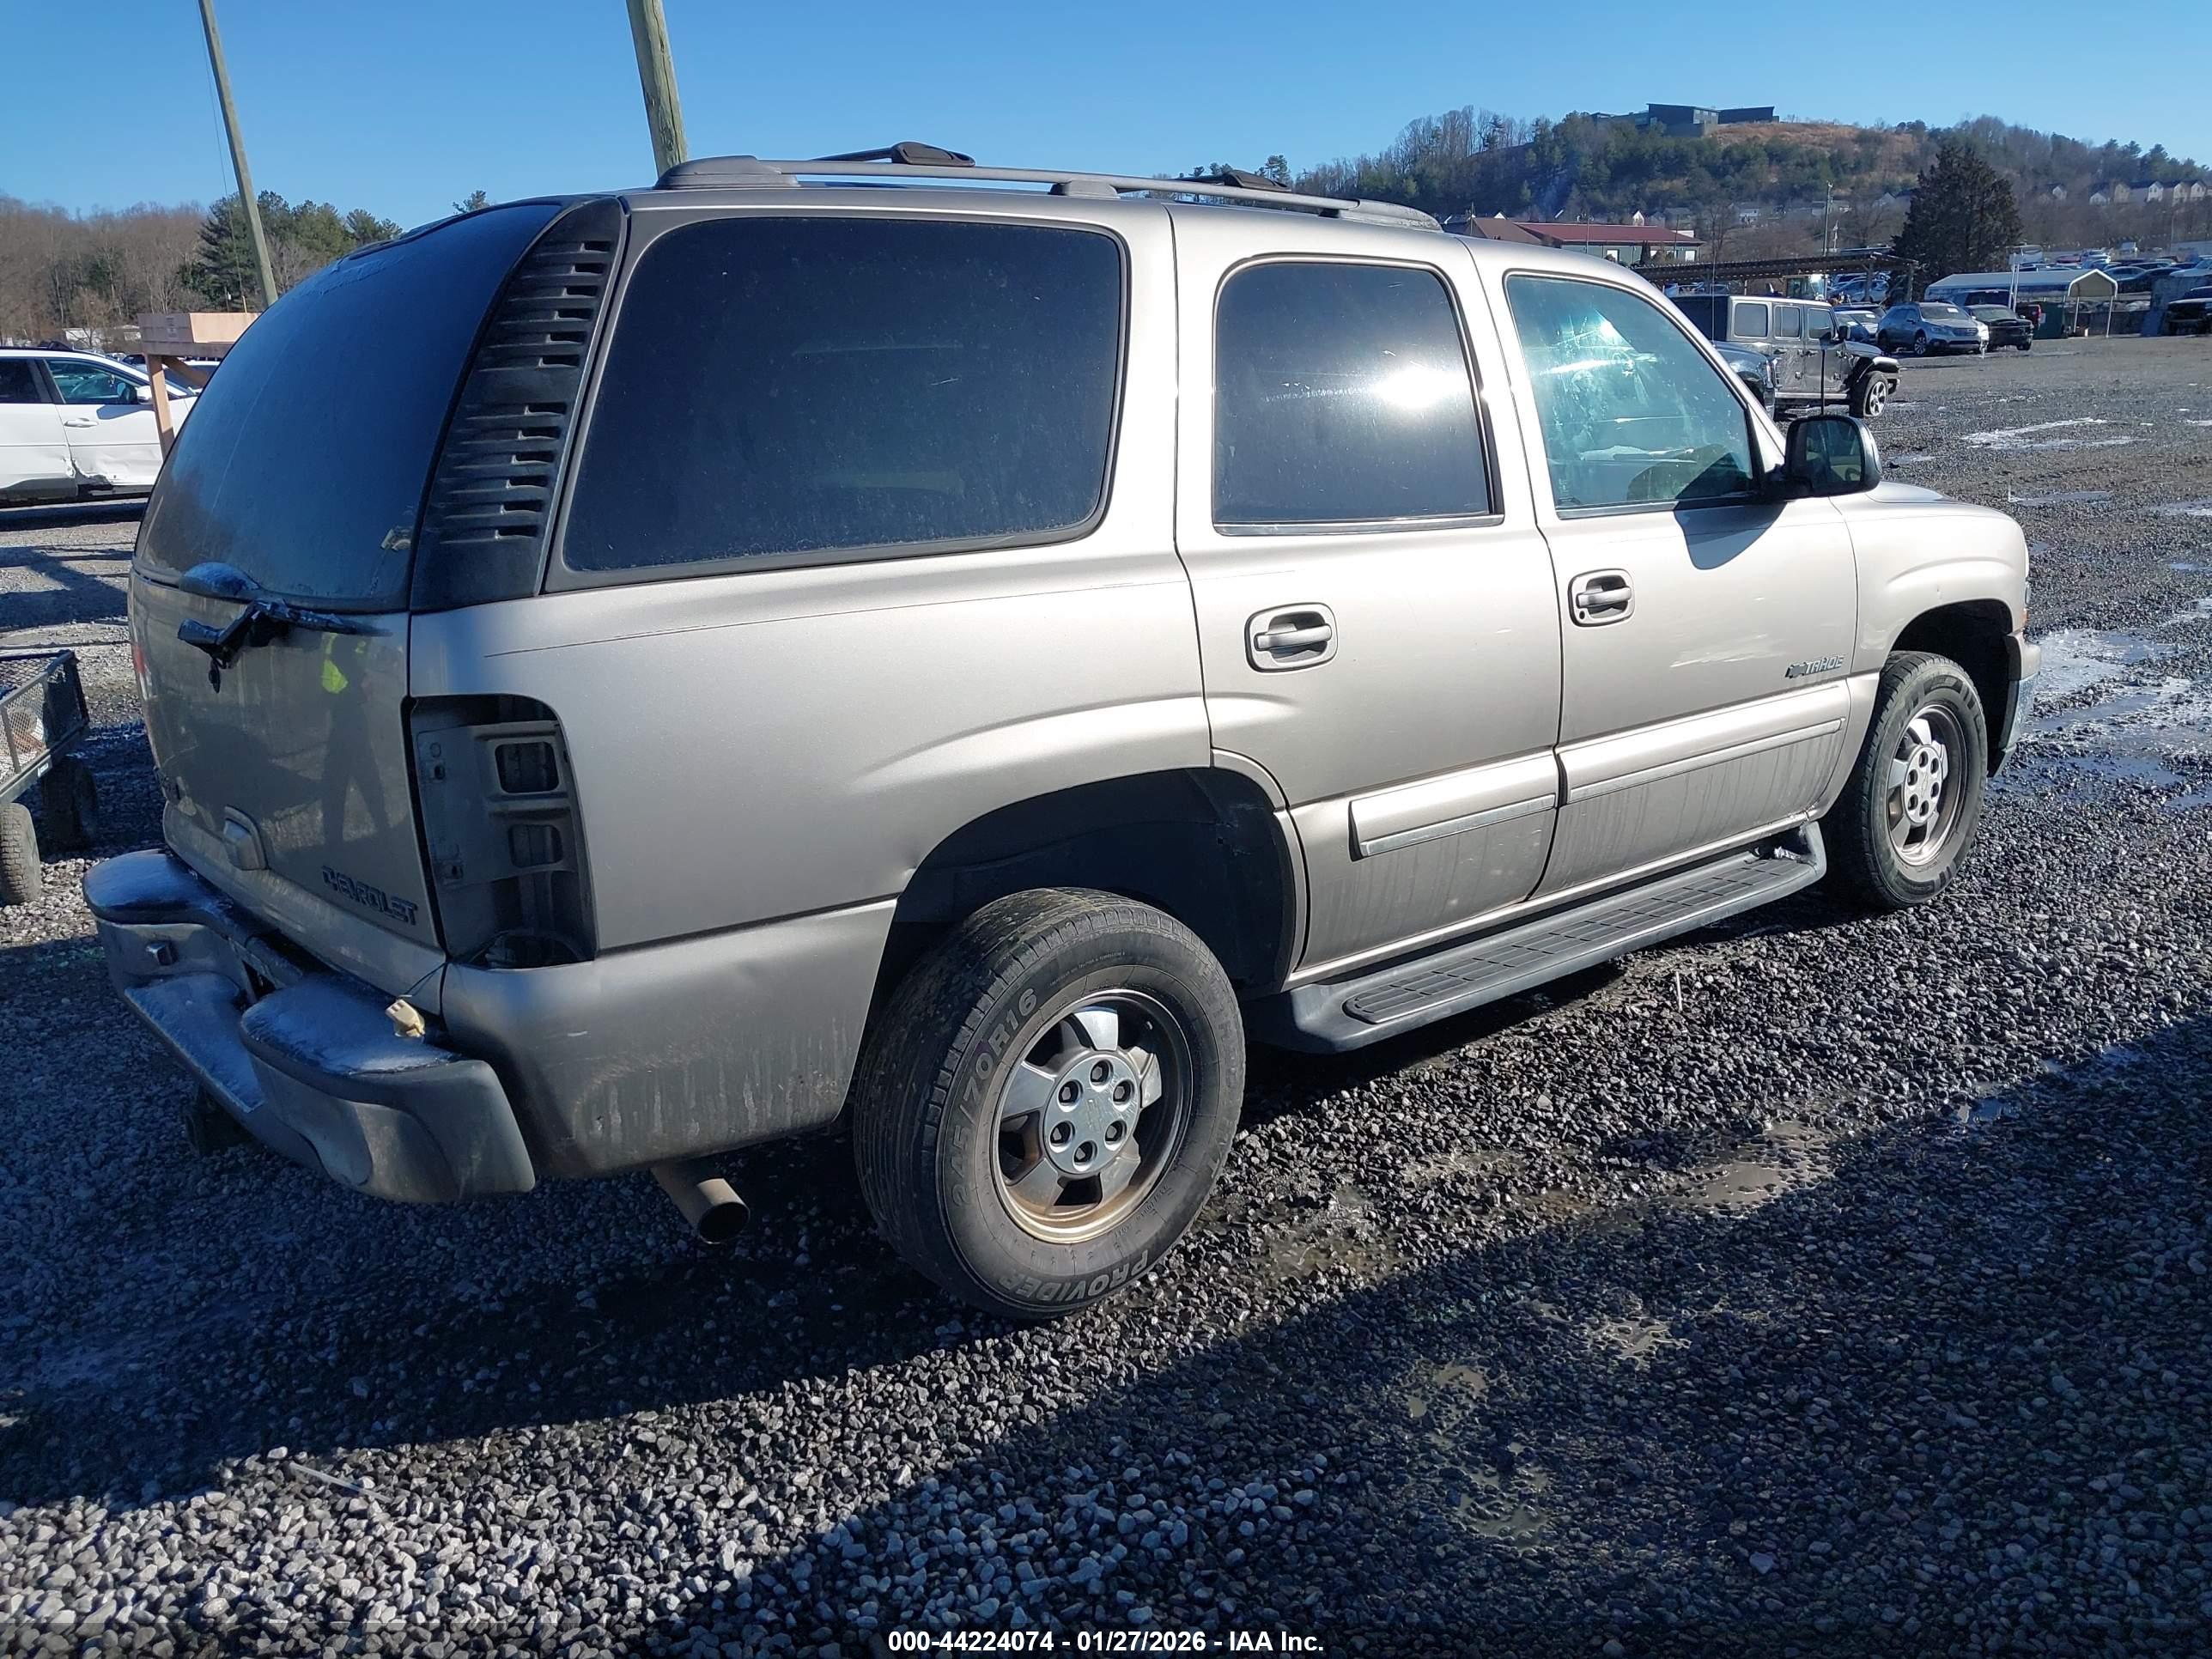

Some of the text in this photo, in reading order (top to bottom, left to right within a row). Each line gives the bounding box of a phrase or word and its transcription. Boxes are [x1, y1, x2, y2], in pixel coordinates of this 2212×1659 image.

[1805, 654, 1845, 675] TAHOE
[951, 988, 1038, 1206] 245/70R16
[999, 1249, 1148, 1302] PROVIDER
